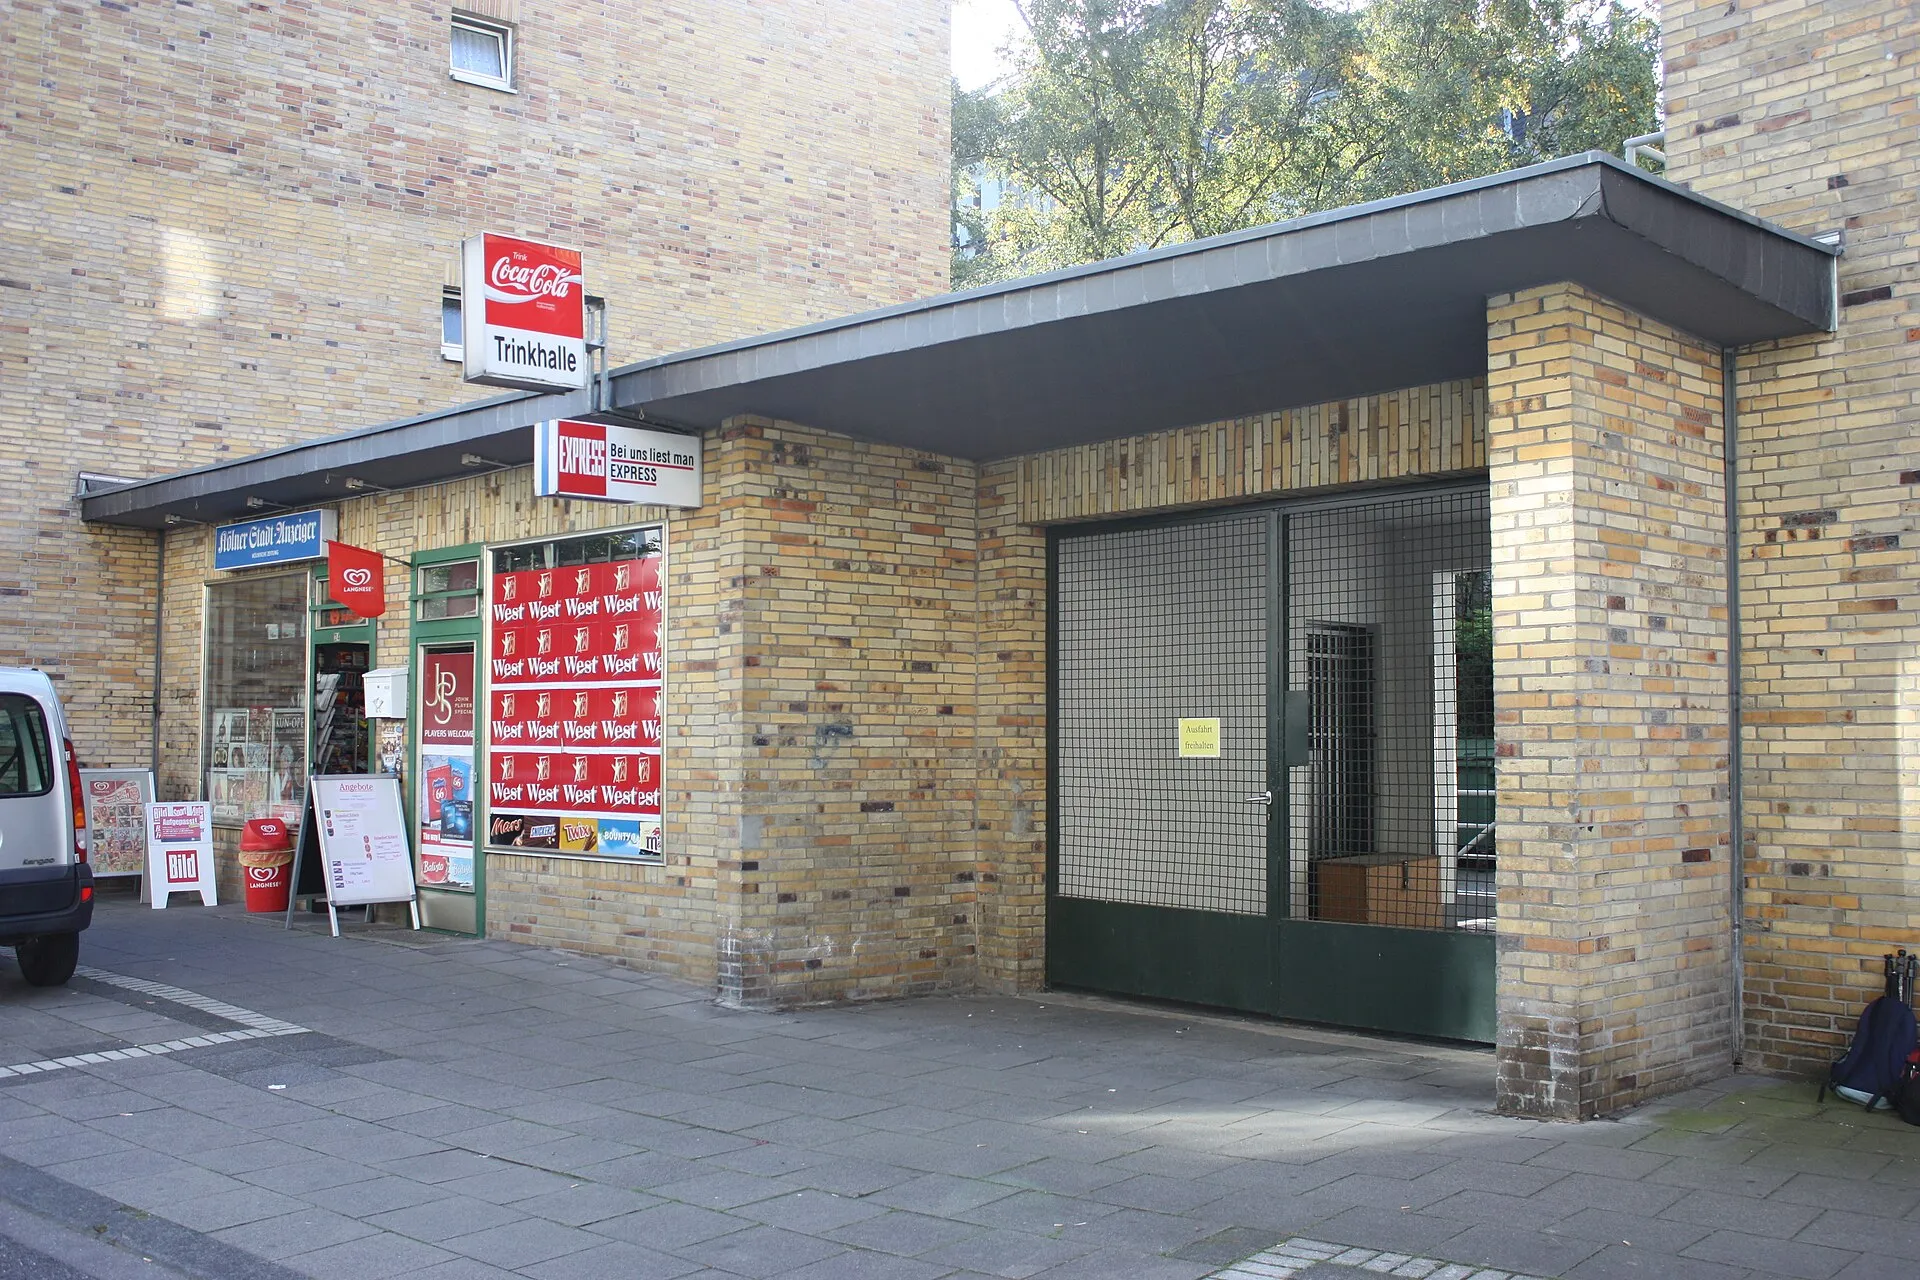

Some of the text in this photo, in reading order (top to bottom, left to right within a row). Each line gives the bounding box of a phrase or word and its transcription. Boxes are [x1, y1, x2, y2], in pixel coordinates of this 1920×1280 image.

[512, 251, 527, 262] Trink
[491, 256, 570, 298] Coca-Cola
[494, 336, 577, 372] Trinkhalle
[559, 436, 606, 477] EXPRESS
[610, 443, 694, 466] Bei uns liest man
[610, 463, 657, 482] EXPRESS
[218, 529, 248, 553] Kölner
[494, 591, 661, 624] West West West West We
[493, 652, 661, 679] West West West West We
[424, 729, 474, 738] PLAYERS WELCOME
[492, 720, 661, 743] West West West West We
[1185, 724, 1213, 735] Ausfahrt
[1184, 740, 1214, 751] freihalten
[339, 782, 374, 793] Angebote
[452, 776, 461, 787] 66
[435, 787, 445, 800] 66
[492, 783, 660, 808] West West West West est
[490, 817, 523, 837] Mars
[531, 825, 554, 837] SNICKERS
[564, 822, 591, 842] Twix
[604, 830, 632, 842] BOUNTY
[169, 854, 196, 879] Bild
[423, 860, 444, 873] Balisto
